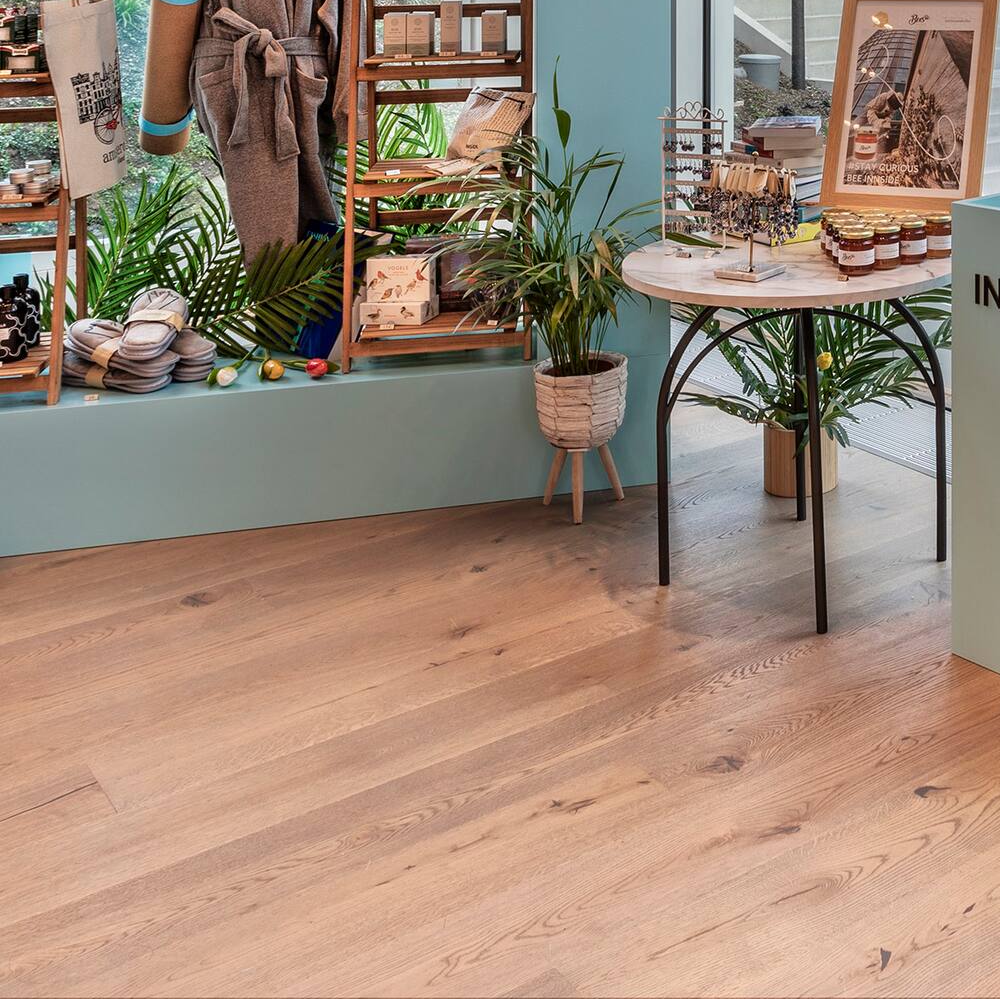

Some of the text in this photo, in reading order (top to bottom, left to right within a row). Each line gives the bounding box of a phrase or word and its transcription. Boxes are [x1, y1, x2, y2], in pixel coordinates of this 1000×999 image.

[848, 162, 919, 173] #STAY CURIOUS
[846, 174, 862, 183] BEE
